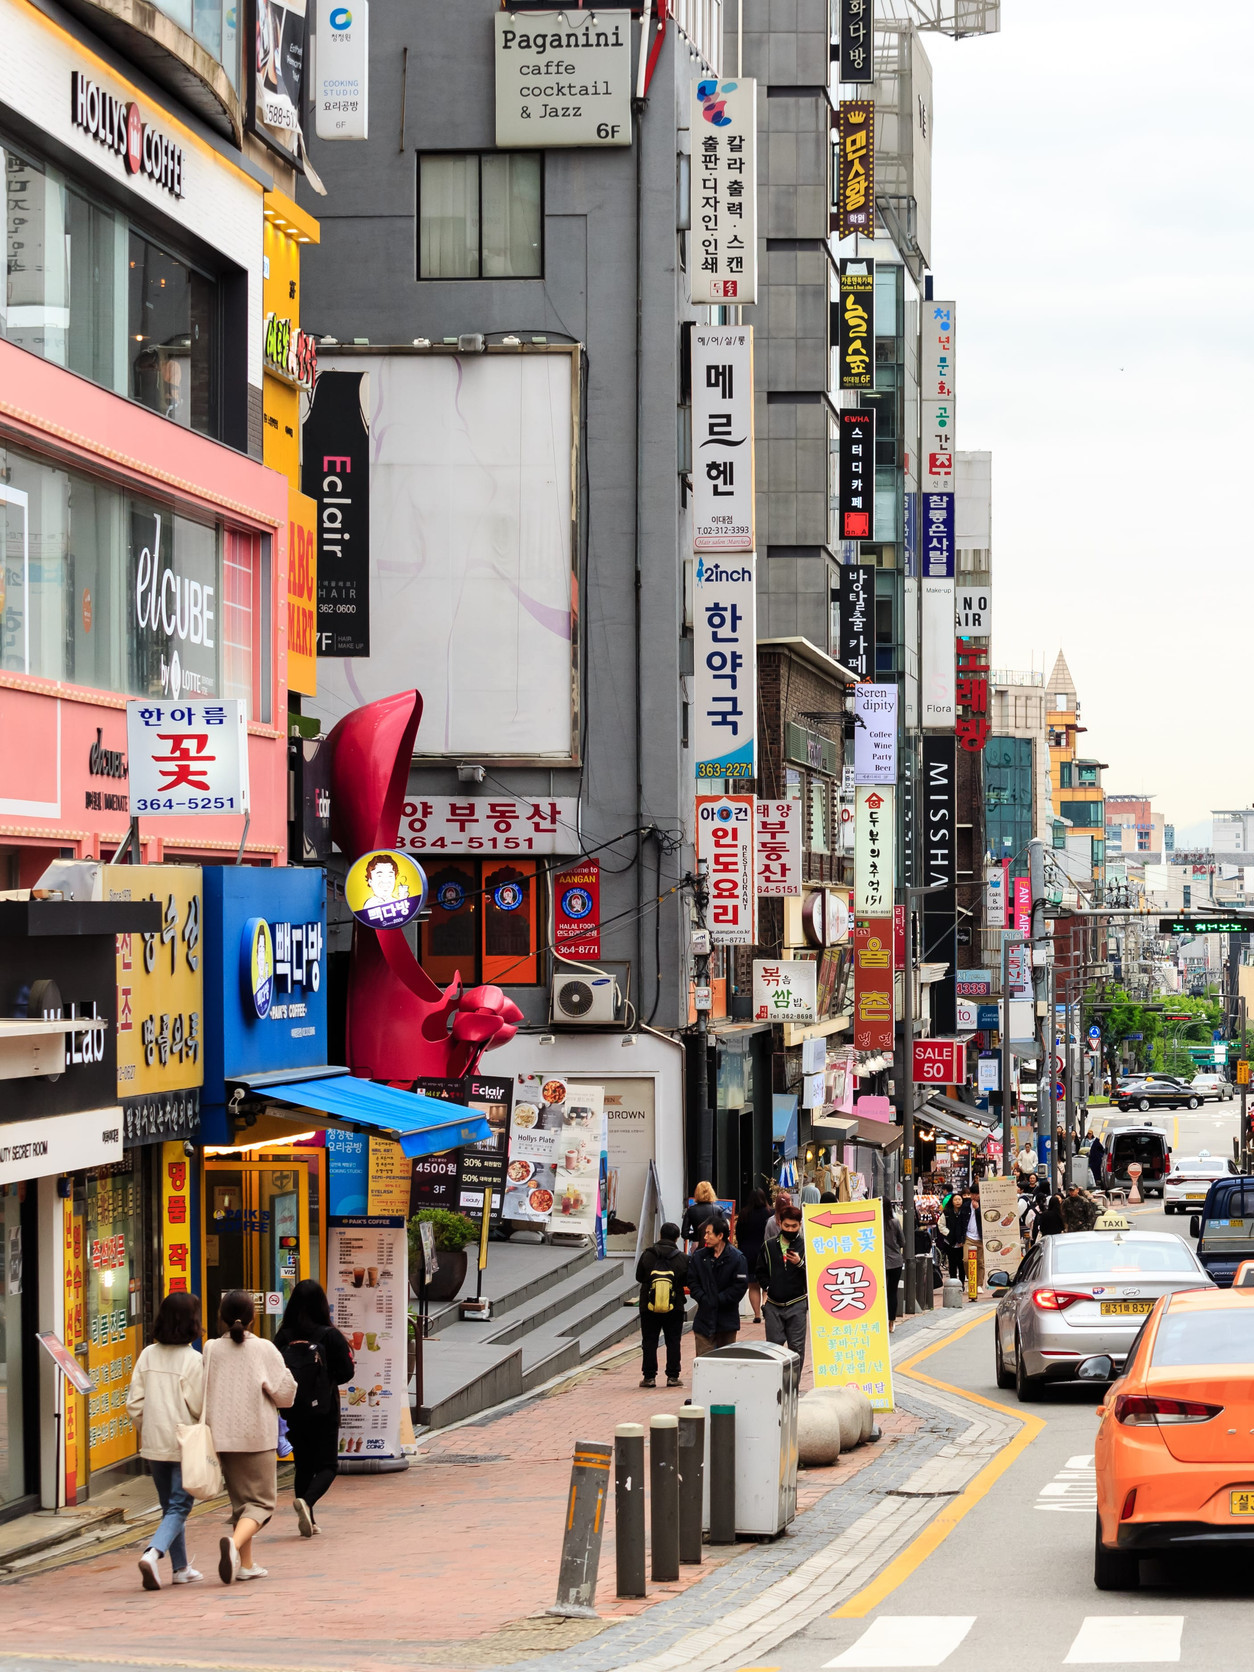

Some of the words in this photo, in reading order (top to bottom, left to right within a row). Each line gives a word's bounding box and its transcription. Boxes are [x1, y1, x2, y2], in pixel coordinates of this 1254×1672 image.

[331, 33, 352, 42] 청정원
[502, 26, 624, 54] Paganini
[519, 61, 576, 76] caffe
[323, 80, 359, 88] COOKING
[519, 81, 613, 97] cocktail
[323, 89, 359, 97] STUDIO
[71, 70, 128, 152] HOLLYS
[323, 101, 359, 112] 요리공방
[520, 105, 532, 119] &
[539, 104, 582, 119] Jazz
[335, 120, 347, 129] 6F
[596, 122, 620, 139] 6F
[142, 122, 187, 199] COFFEE
[849, 213, 865, 223] 학원
[860, 374, 871, 384] 6F
[933, 307, 952, 450] 청년문화공간
[706, 364, 734, 497] 메르헨
[851, 427, 864, 509] 스터디카페
[322, 455, 352, 558] Eclair
[711, 515, 733, 524] 이대점
[929, 495, 950, 576] 참좋은사람들
[288, 520, 314, 603] ABC
[318, 588, 357, 599] HAIR
[849, 569, 867, 631] 방탈출
[288, 607, 314, 658] MART
[849, 635, 867, 675] 카페
[705, 602, 744, 736] 한약국
[856, 687, 887, 698] Seren
[863, 699, 895, 712] dipity
[926, 704, 952, 713] Flora
[138, 706, 228, 727] 한아름
[869, 731, 892, 739] Coffee
[151, 733, 217, 793] 꽃
[872, 753, 892, 762] Party
[699, 763, 752, 777] 363-2271
[136, 797, 236, 812] 364-5251
[446, 801, 562, 834] 부동산
[757, 821, 791, 883] 부동산
[559, 875, 596, 883] AANGAN
[711, 827, 740, 926] 인도요리
[757, 885, 798, 894] 64-5151
[865, 894, 883, 906] 151
[558, 945, 598, 954] 364-8771
[275, 921, 323, 994] 빽다방
[915, 1047, 952, 1060] SALE
[922, 1063, 944, 1078] 50
[471, 1083, 505, 1097] Eclair
[607, 1110, 646, 1120] BROWN
[517, 1133, 538, 1144] Hollys
[539, 1135, 556, 1145] Plate
[12, 1142, 33, 1161] SECRET
[32, 1140, 48, 1157] ROOM
[327, 1141, 363, 1154] 요리공방
[415, 1162, 457, 1176] 4500원
[463, 1158, 482, 1168] 30%
[461, 1174, 479, 1183] 50%
[167, 1161, 187, 1224] 명품
[433, 1185, 446, 1194] 3F
[1101, 1218, 1125, 1228] TAXI
[812, 1235, 853, 1254] 한아름
[857, 1228, 876, 1253] 꽃
[823, 1265, 871, 1312] 꽃
[862, 1381, 886, 1395] 배달
